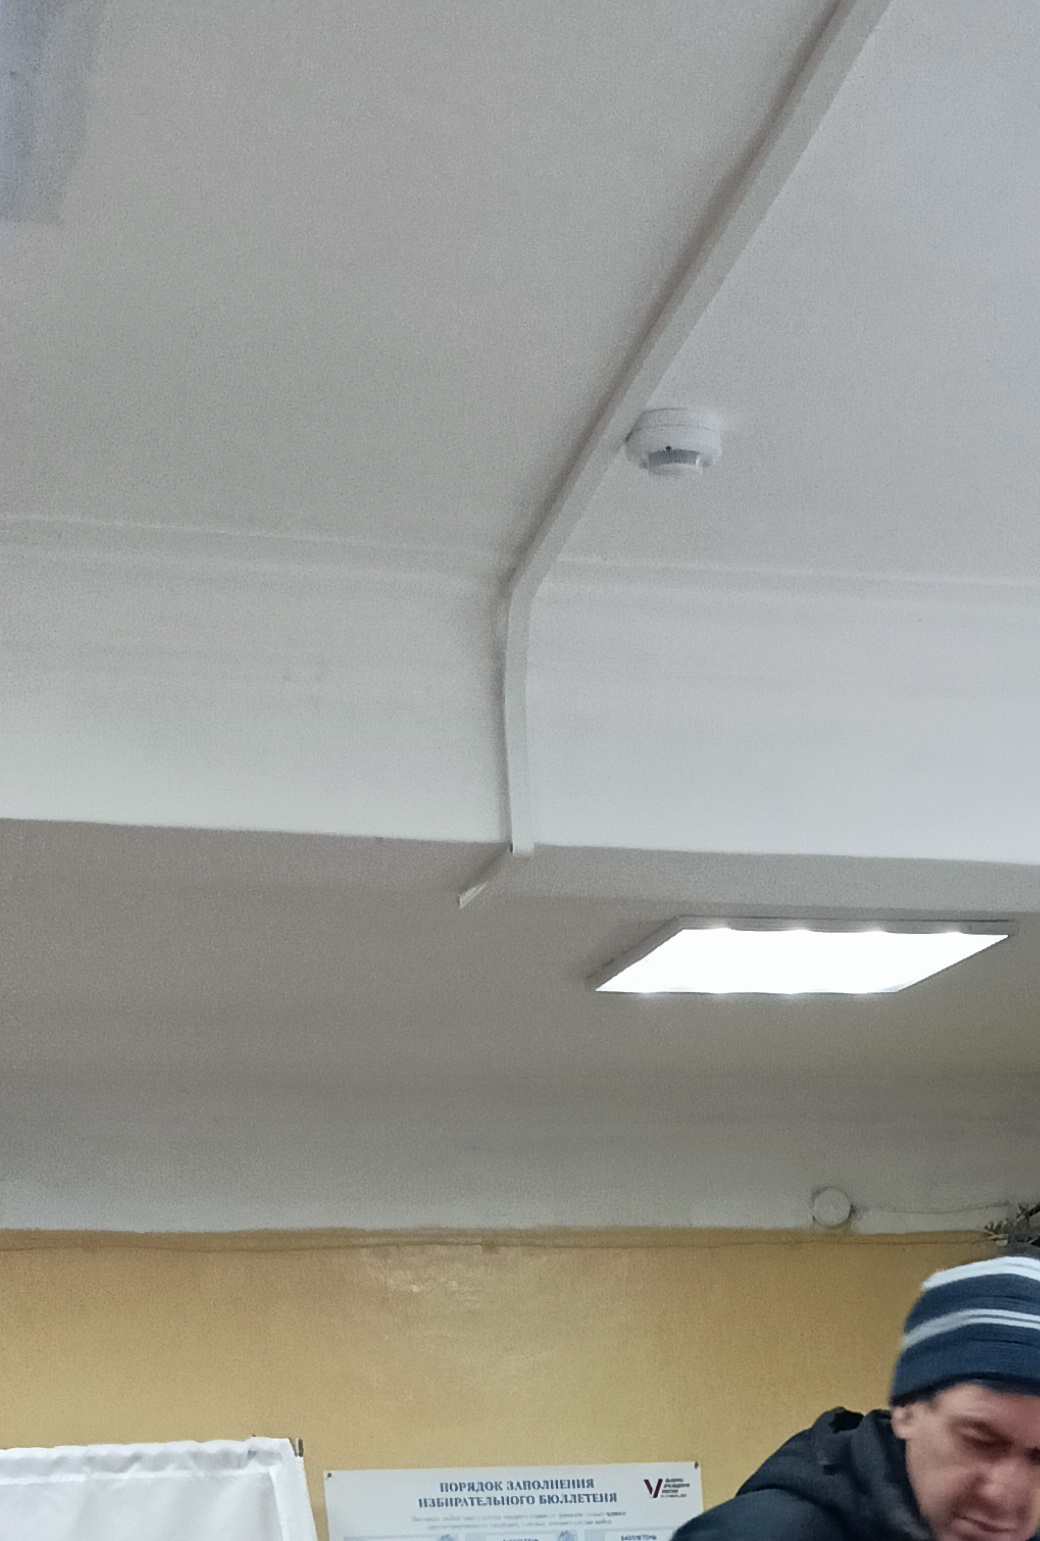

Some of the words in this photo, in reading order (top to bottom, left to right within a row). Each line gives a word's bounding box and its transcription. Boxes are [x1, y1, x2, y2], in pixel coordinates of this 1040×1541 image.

[440, 1480, 503, 1493] ПОРЯДОК
[506, 1478, 595, 1491] ЗАПОЛНЕНИЯ
[418, 1495, 536, 1508] ИЗБИРАТЕЛЬНОГО
[539, 1492, 618, 1505] БЮЛЛЕТЕНЯ
